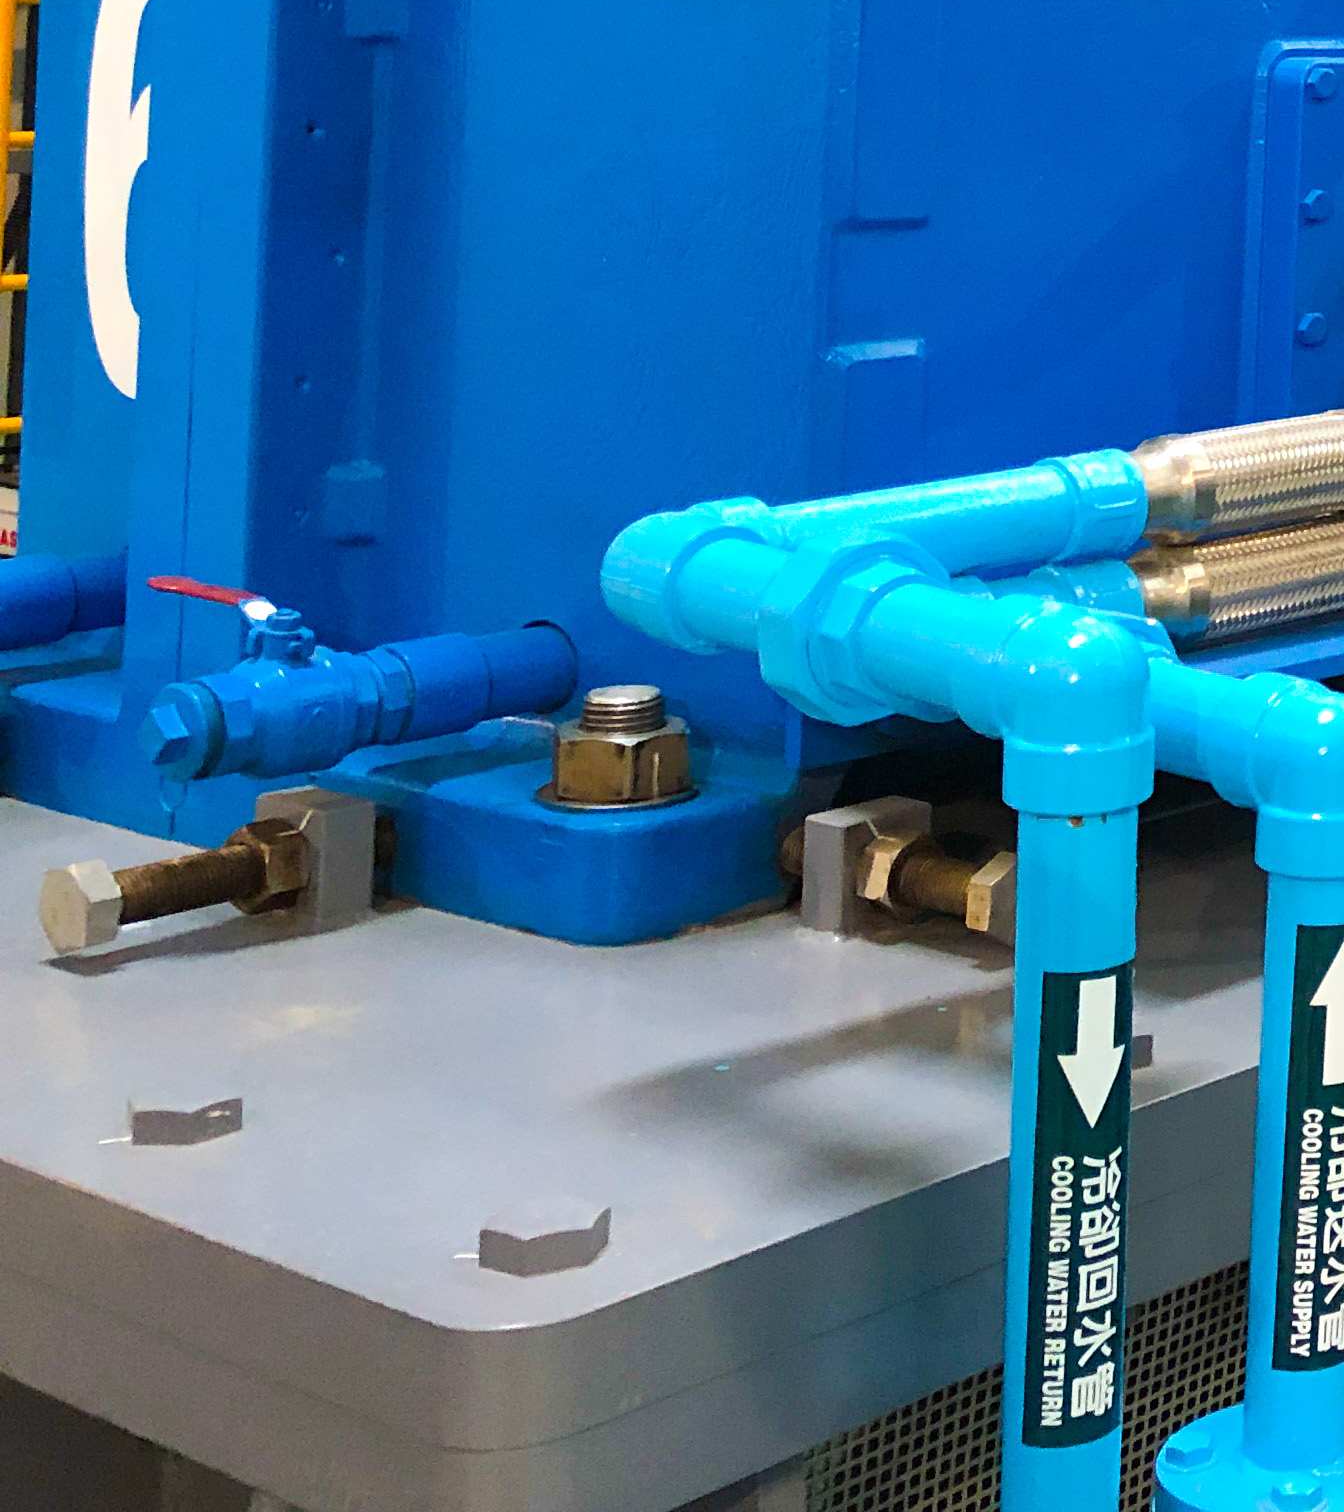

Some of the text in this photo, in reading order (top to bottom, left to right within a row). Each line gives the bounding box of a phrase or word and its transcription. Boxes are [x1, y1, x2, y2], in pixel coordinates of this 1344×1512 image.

[1040, 1155, 1075, 1426] COOLING WATER RETURN
[1070, 1146, 1123, 1418] 冷卻回水管
[1290, 1108, 1324, 1357] COOLING WATER SUPPLY
